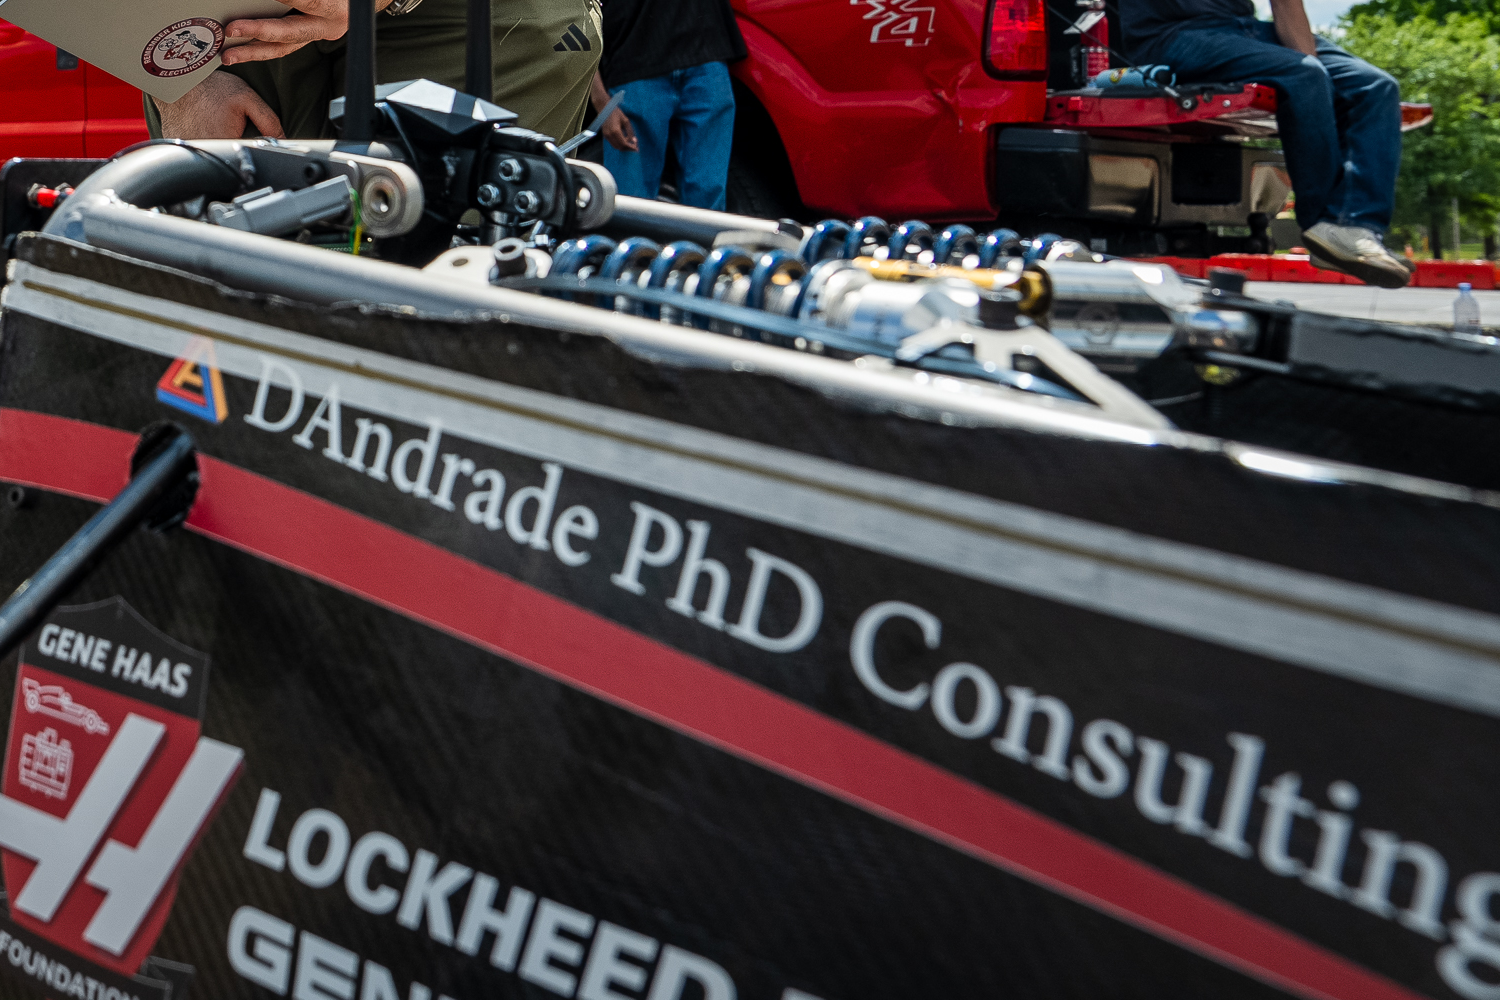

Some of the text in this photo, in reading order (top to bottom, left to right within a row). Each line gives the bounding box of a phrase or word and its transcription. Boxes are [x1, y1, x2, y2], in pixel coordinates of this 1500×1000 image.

[143, 19, 193, 65] REMEMBER KIDS
[205, 20, 218, 31] YOU
[207, 42, 221, 57] WILL
[159, 56, 209, 77] ELECTRICITY
[242, 353, 599, 567] DAndrade
[610, 499, 824, 654] PhD
[37, 622, 193, 699] GENE HAAS
